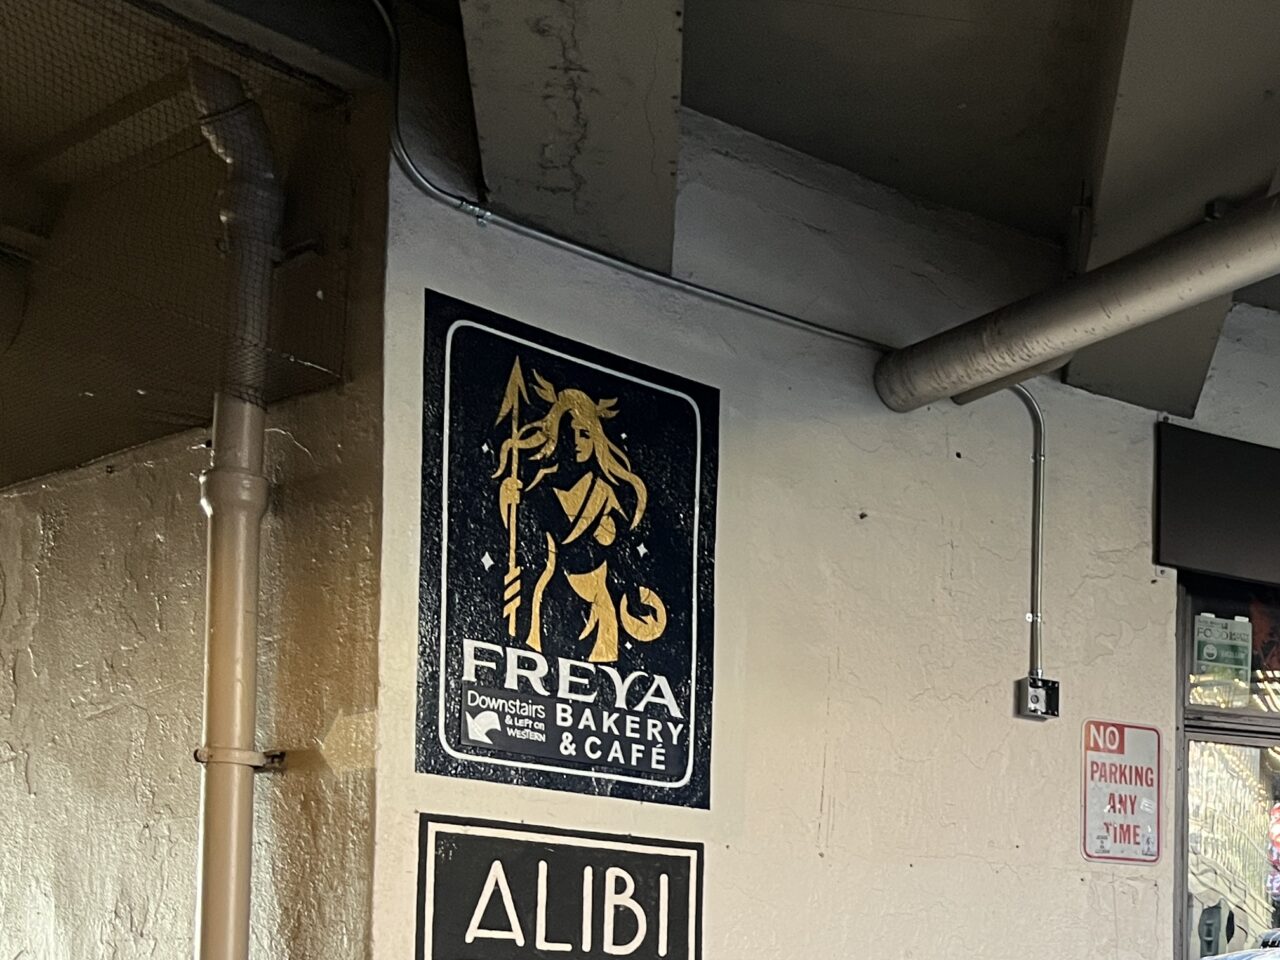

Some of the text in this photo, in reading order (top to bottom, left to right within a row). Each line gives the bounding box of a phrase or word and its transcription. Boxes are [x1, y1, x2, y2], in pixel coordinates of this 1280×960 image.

[462, 638, 684, 718] FREYA
[468, 690, 546, 719] Downstairs
[504, 716, 513, 725] &
[555, 702, 684, 745] BAKERY
[506, 727, 546, 742] WESTERN
[1090, 724, 1120, 750] NO
[559, 733, 666, 770] & CAFÉ
[1090, 761, 1154, 787] PARKING
[1107, 792, 1137, 815] ANY
[1104, 822, 1140, 846] TIME
[465, 860, 668, 957] ALIBI
